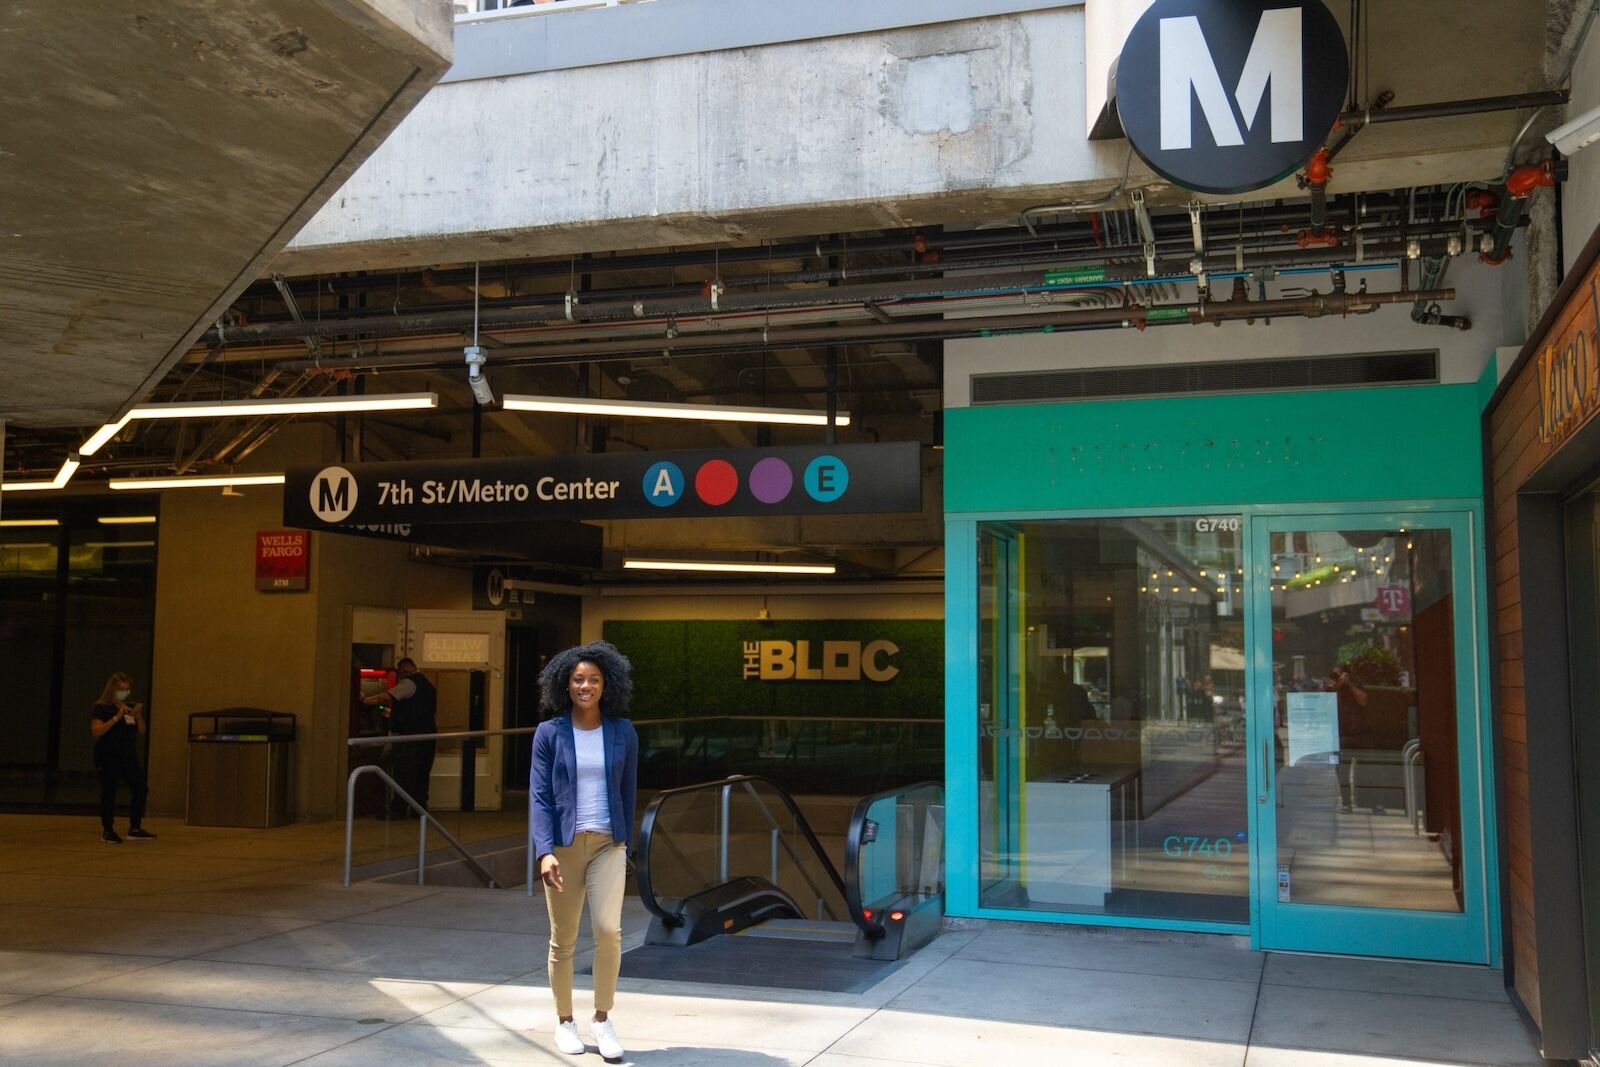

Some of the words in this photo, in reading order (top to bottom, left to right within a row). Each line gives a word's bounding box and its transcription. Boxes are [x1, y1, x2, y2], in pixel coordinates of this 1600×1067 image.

[1159, 6, 1304, 151] M
[1057, 277, 1072, 285] VENT
[1075, 274, 1104, 284] SANITARY
[318, 477, 349, 512] M
[377, 479, 414, 505] 7th
[421, 478, 529, 504] St/Metro
[536, 476, 620, 502] Center
[652, 468, 675, 497] A
[817, 465, 835, 492] E
[1195, 517, 1239, 533] G740
[261, 535, 303, 546] WELLS
[262, 546, 303, 558] FARGO
[273, 579, 289, 587] ATM
[743, 641, 760, 680] THE
[760, 639, 900, 682] BLOC
[1163, 835, 1232, 859] G740
